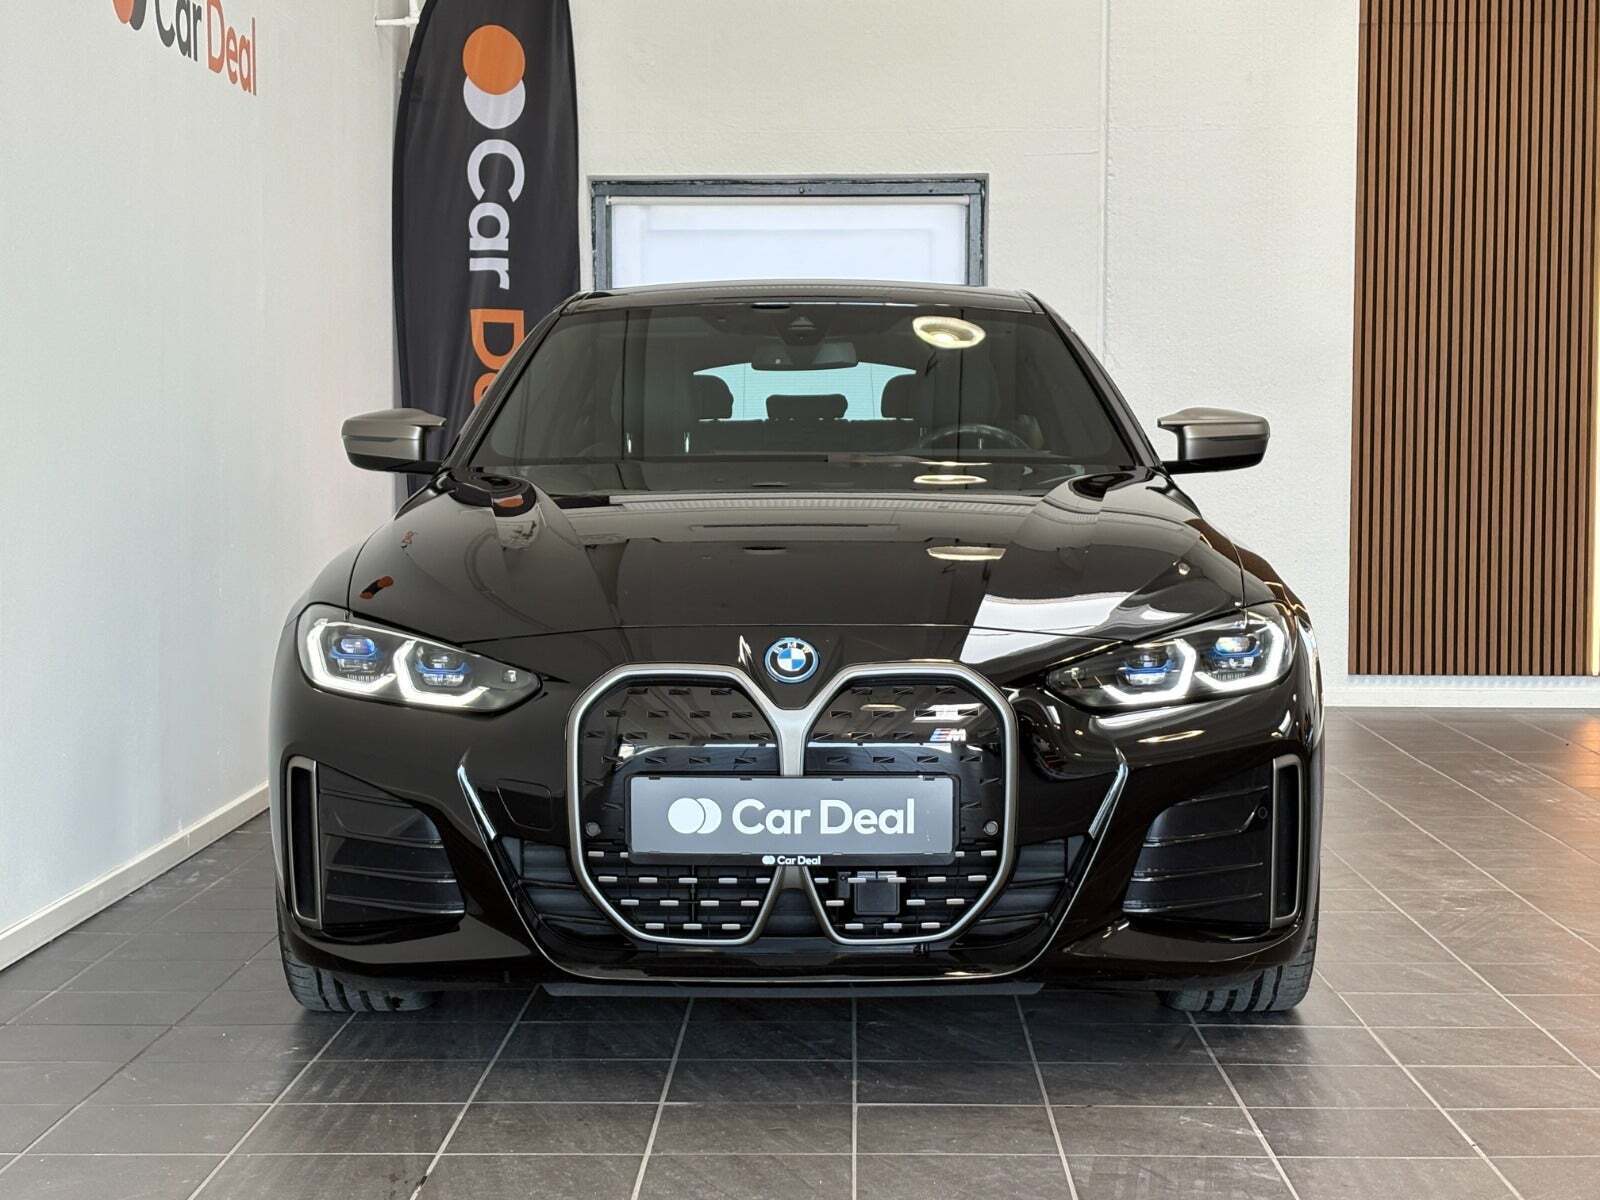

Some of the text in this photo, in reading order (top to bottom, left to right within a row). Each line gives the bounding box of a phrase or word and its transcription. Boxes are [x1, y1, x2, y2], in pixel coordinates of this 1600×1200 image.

[154, 0, 257, 96] Car Deal
[467, 139, 525, 290] Car
[731, 798, 915, 835] Car Deal
[777, 855, 821, 865] Car Deal
